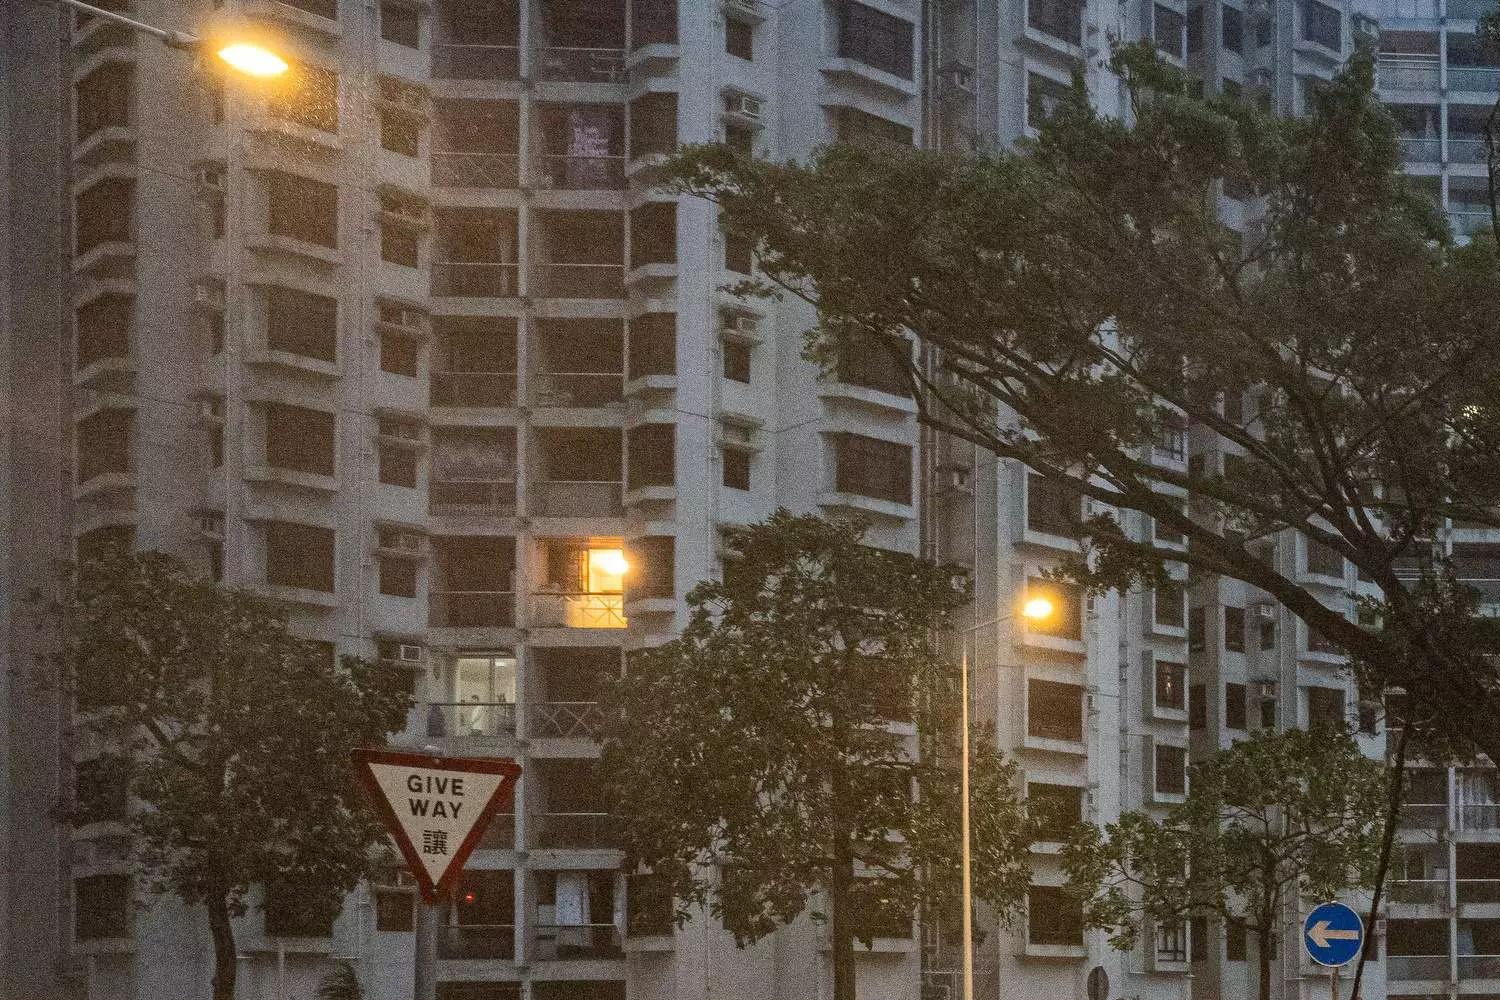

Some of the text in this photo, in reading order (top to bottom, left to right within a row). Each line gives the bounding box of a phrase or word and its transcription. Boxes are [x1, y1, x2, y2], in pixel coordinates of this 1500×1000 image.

[407, 774, 464, 797] GIVE
[408, 798, 463, 819] WAY
[422, 829, 449, 856] 讓
